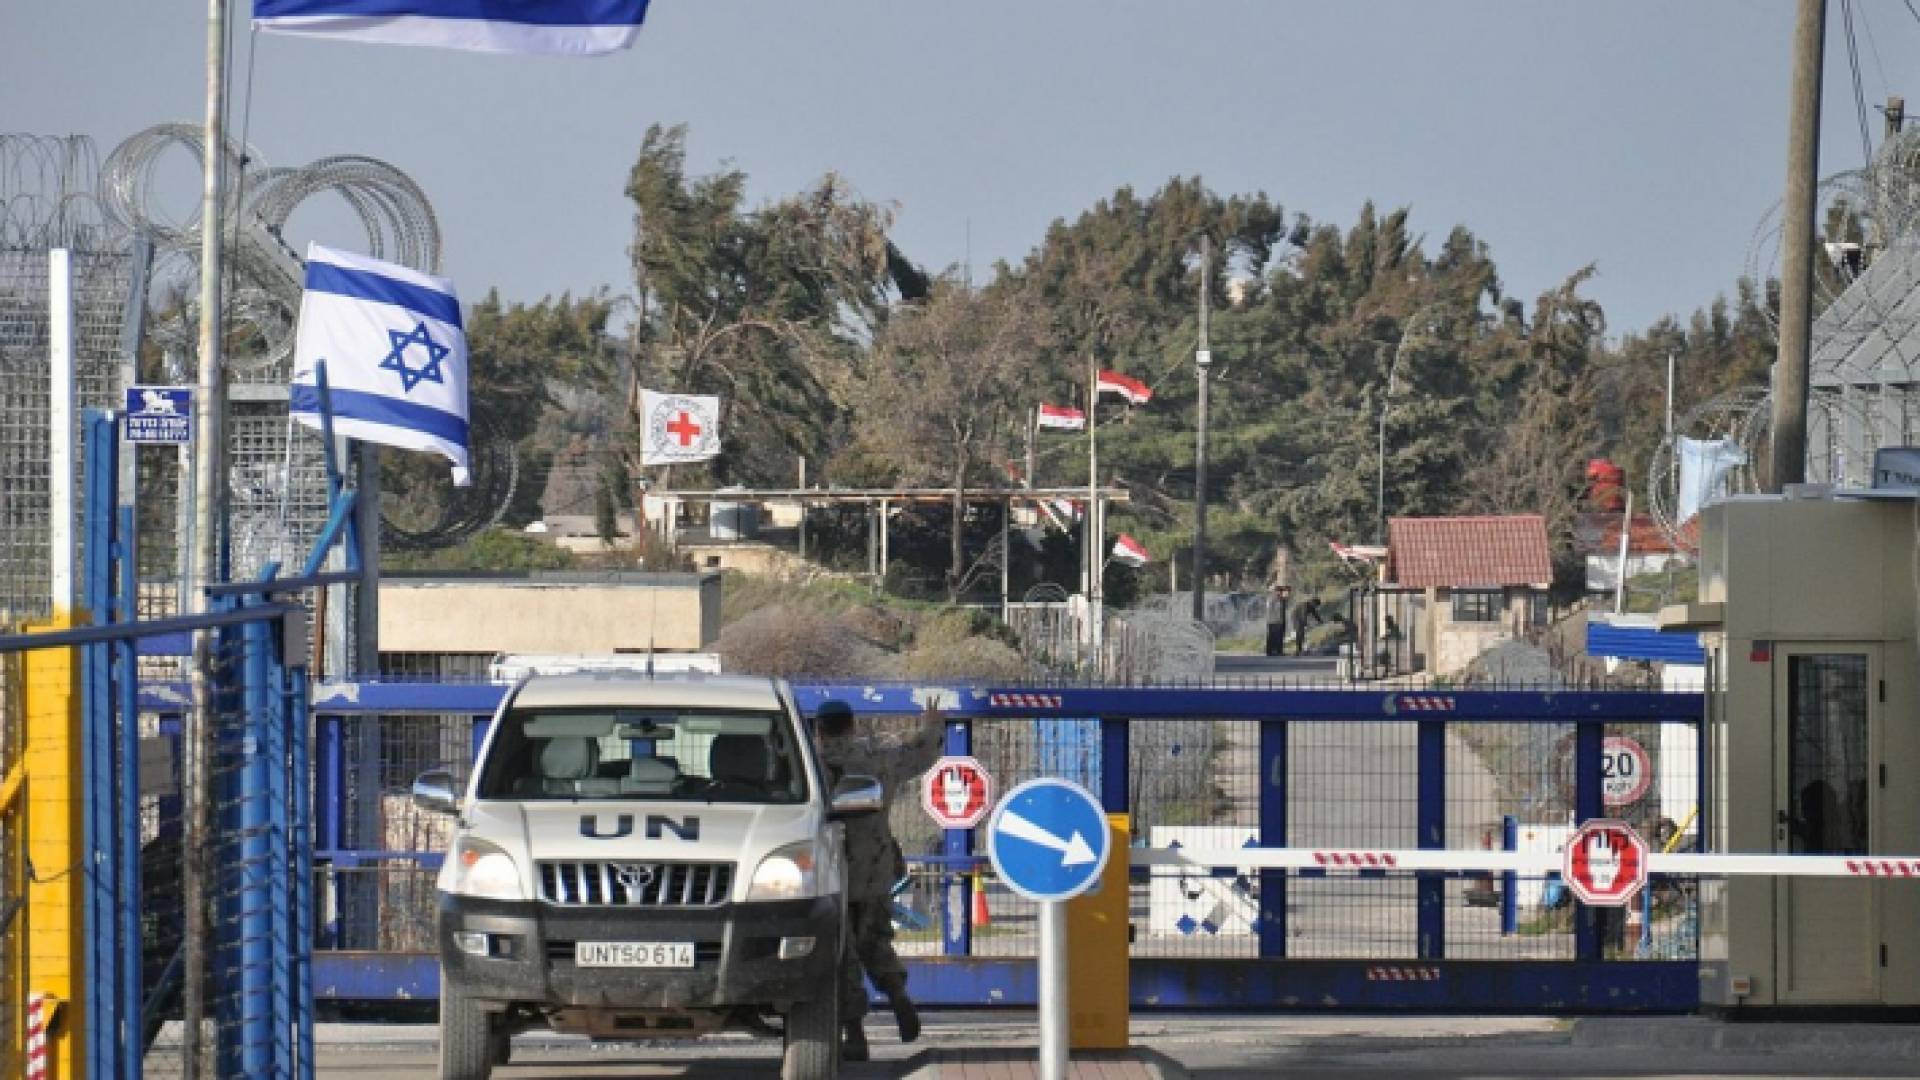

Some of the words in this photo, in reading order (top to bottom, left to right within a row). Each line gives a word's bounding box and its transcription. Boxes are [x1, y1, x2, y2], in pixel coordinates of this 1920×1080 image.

[1602, 753, 1633, 777] 20
[579, 814, 700, 841] UN
[579, 944, 649, 963] UNTSO
[653, 944, 690, 964] 614
